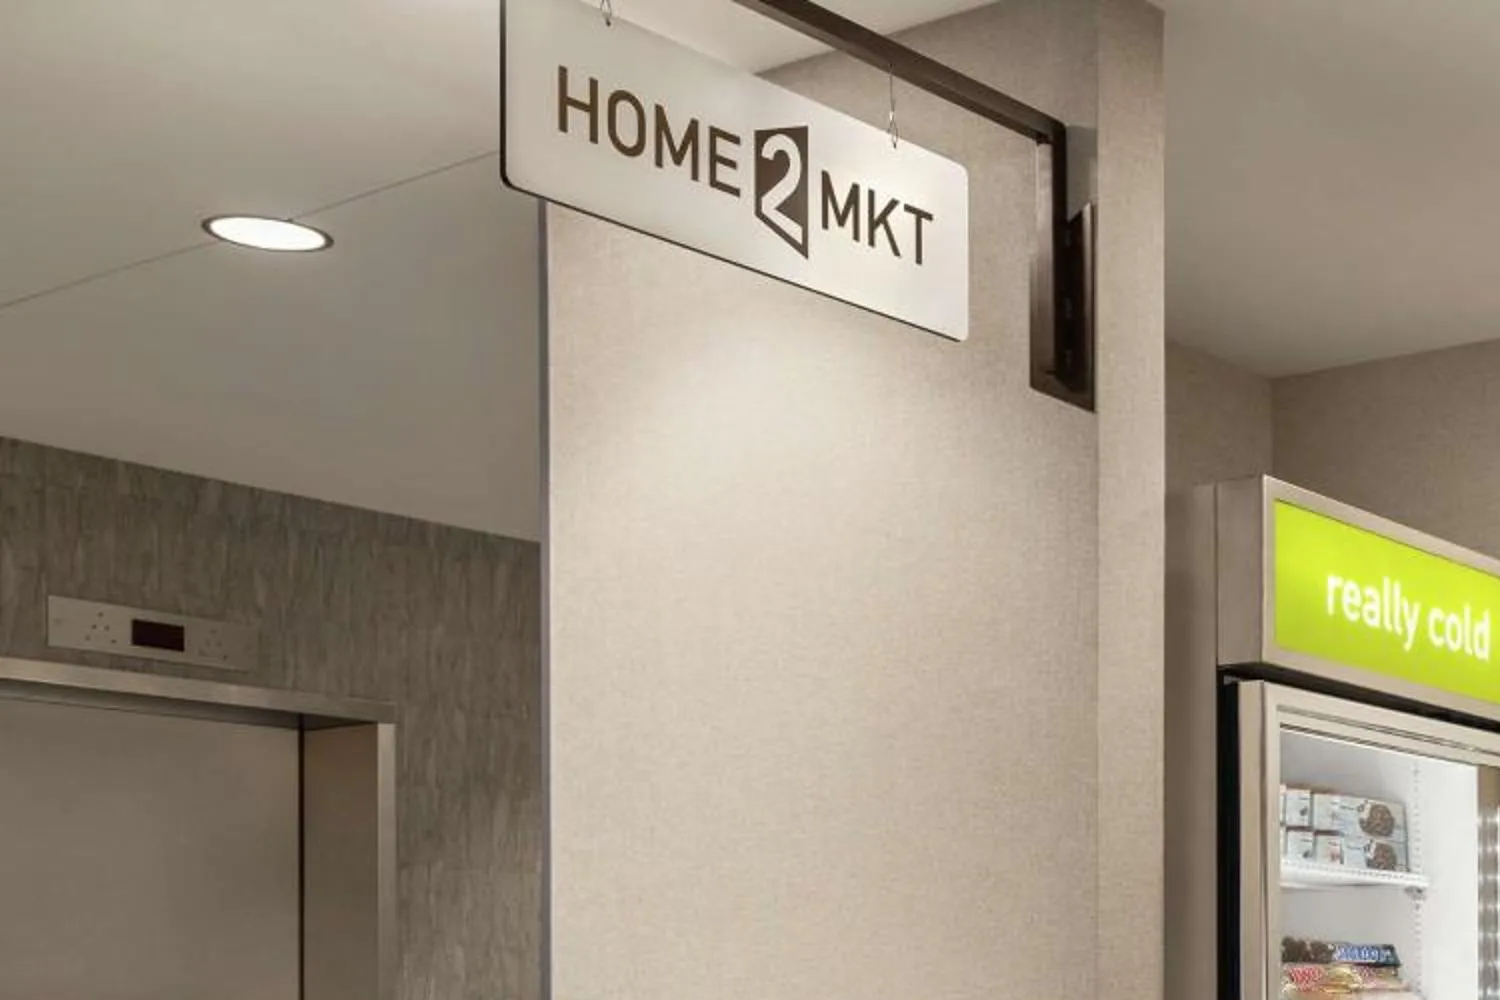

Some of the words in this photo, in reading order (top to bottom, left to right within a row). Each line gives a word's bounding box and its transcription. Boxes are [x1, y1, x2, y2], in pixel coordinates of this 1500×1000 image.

[558, 65, 741, 198] HOME
[821, 170, 933, 265] MKT
[1327, 575, 1420, 651] really
[1428, 603, 1491, 661] cold
